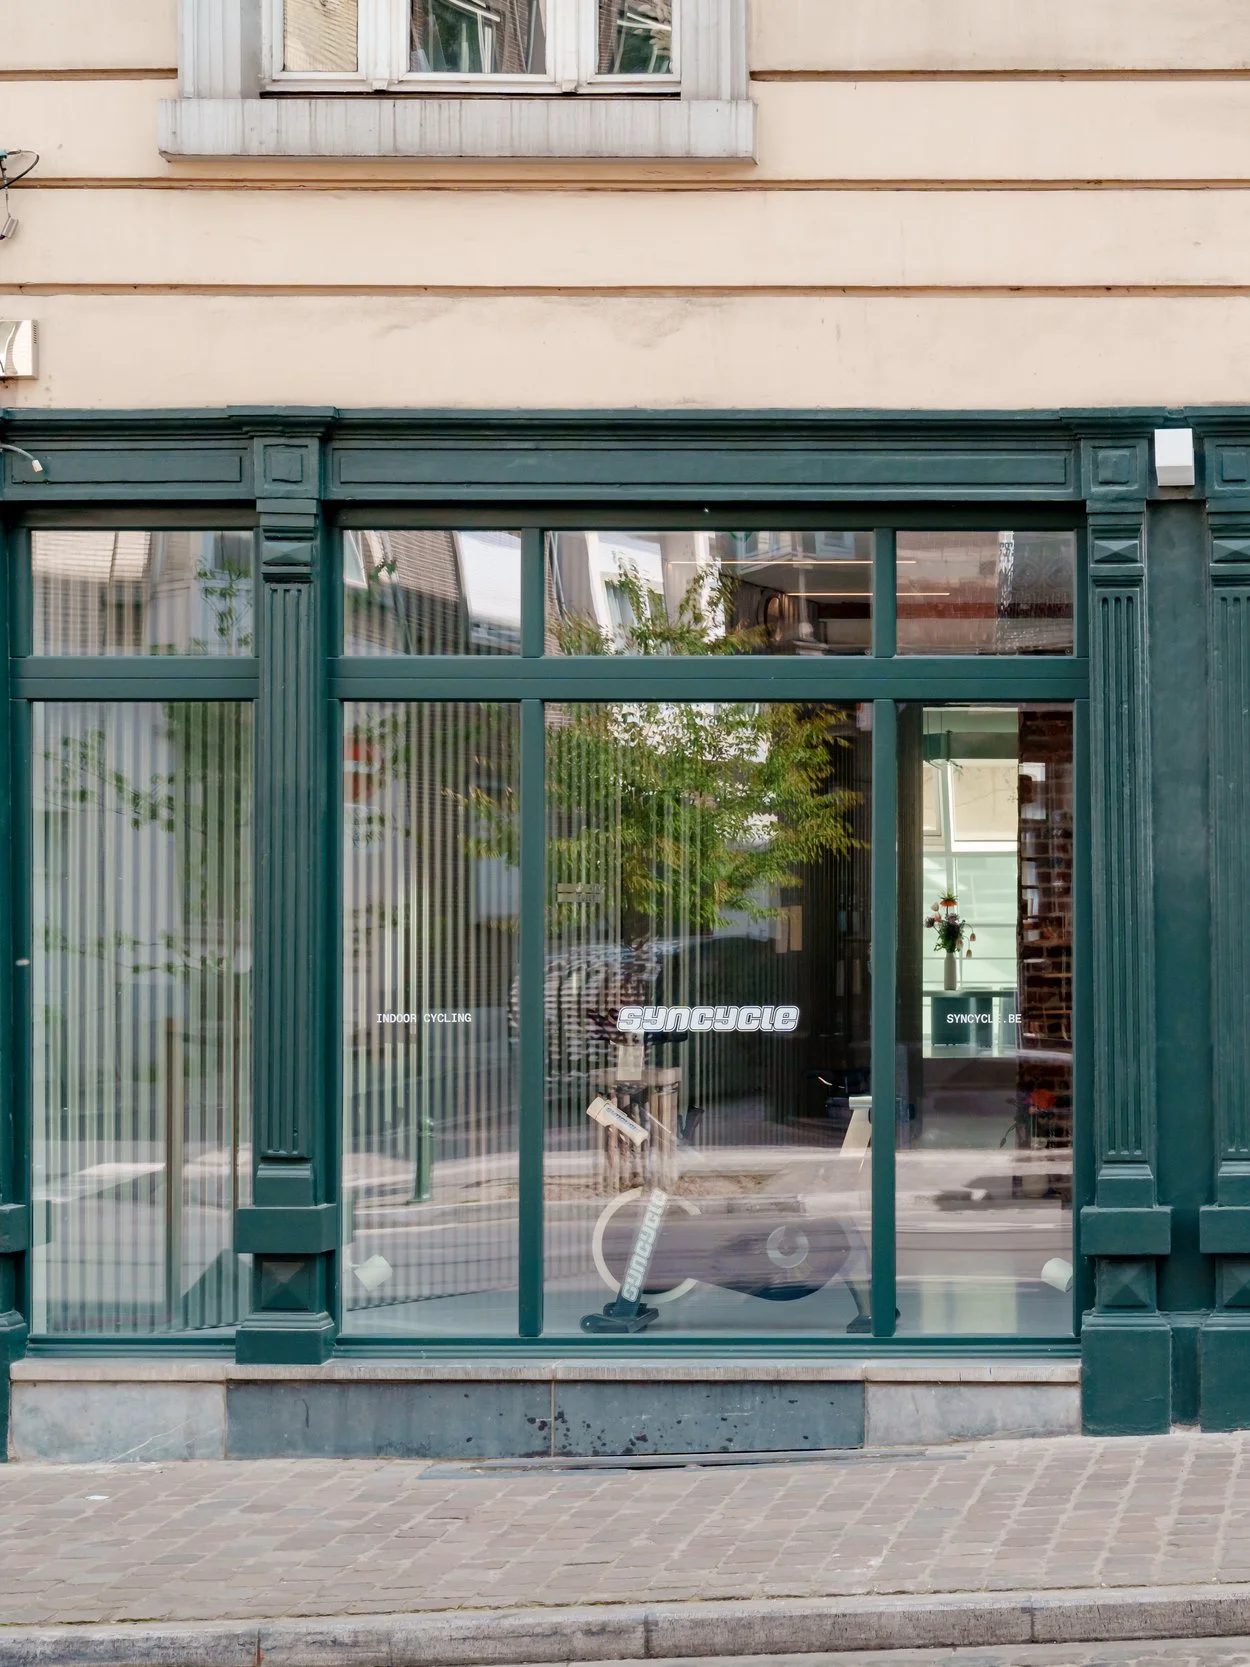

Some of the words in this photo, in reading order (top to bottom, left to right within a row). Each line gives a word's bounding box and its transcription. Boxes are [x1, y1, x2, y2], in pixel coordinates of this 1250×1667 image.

[376, 1013, 417, 1023] INDOOR
[423, 1013, 472, 1023] CYCLING
[616, 1005, 800, 1032] syncycle
[946, 1013, 1022, 1024] SYNCYCL.BE
